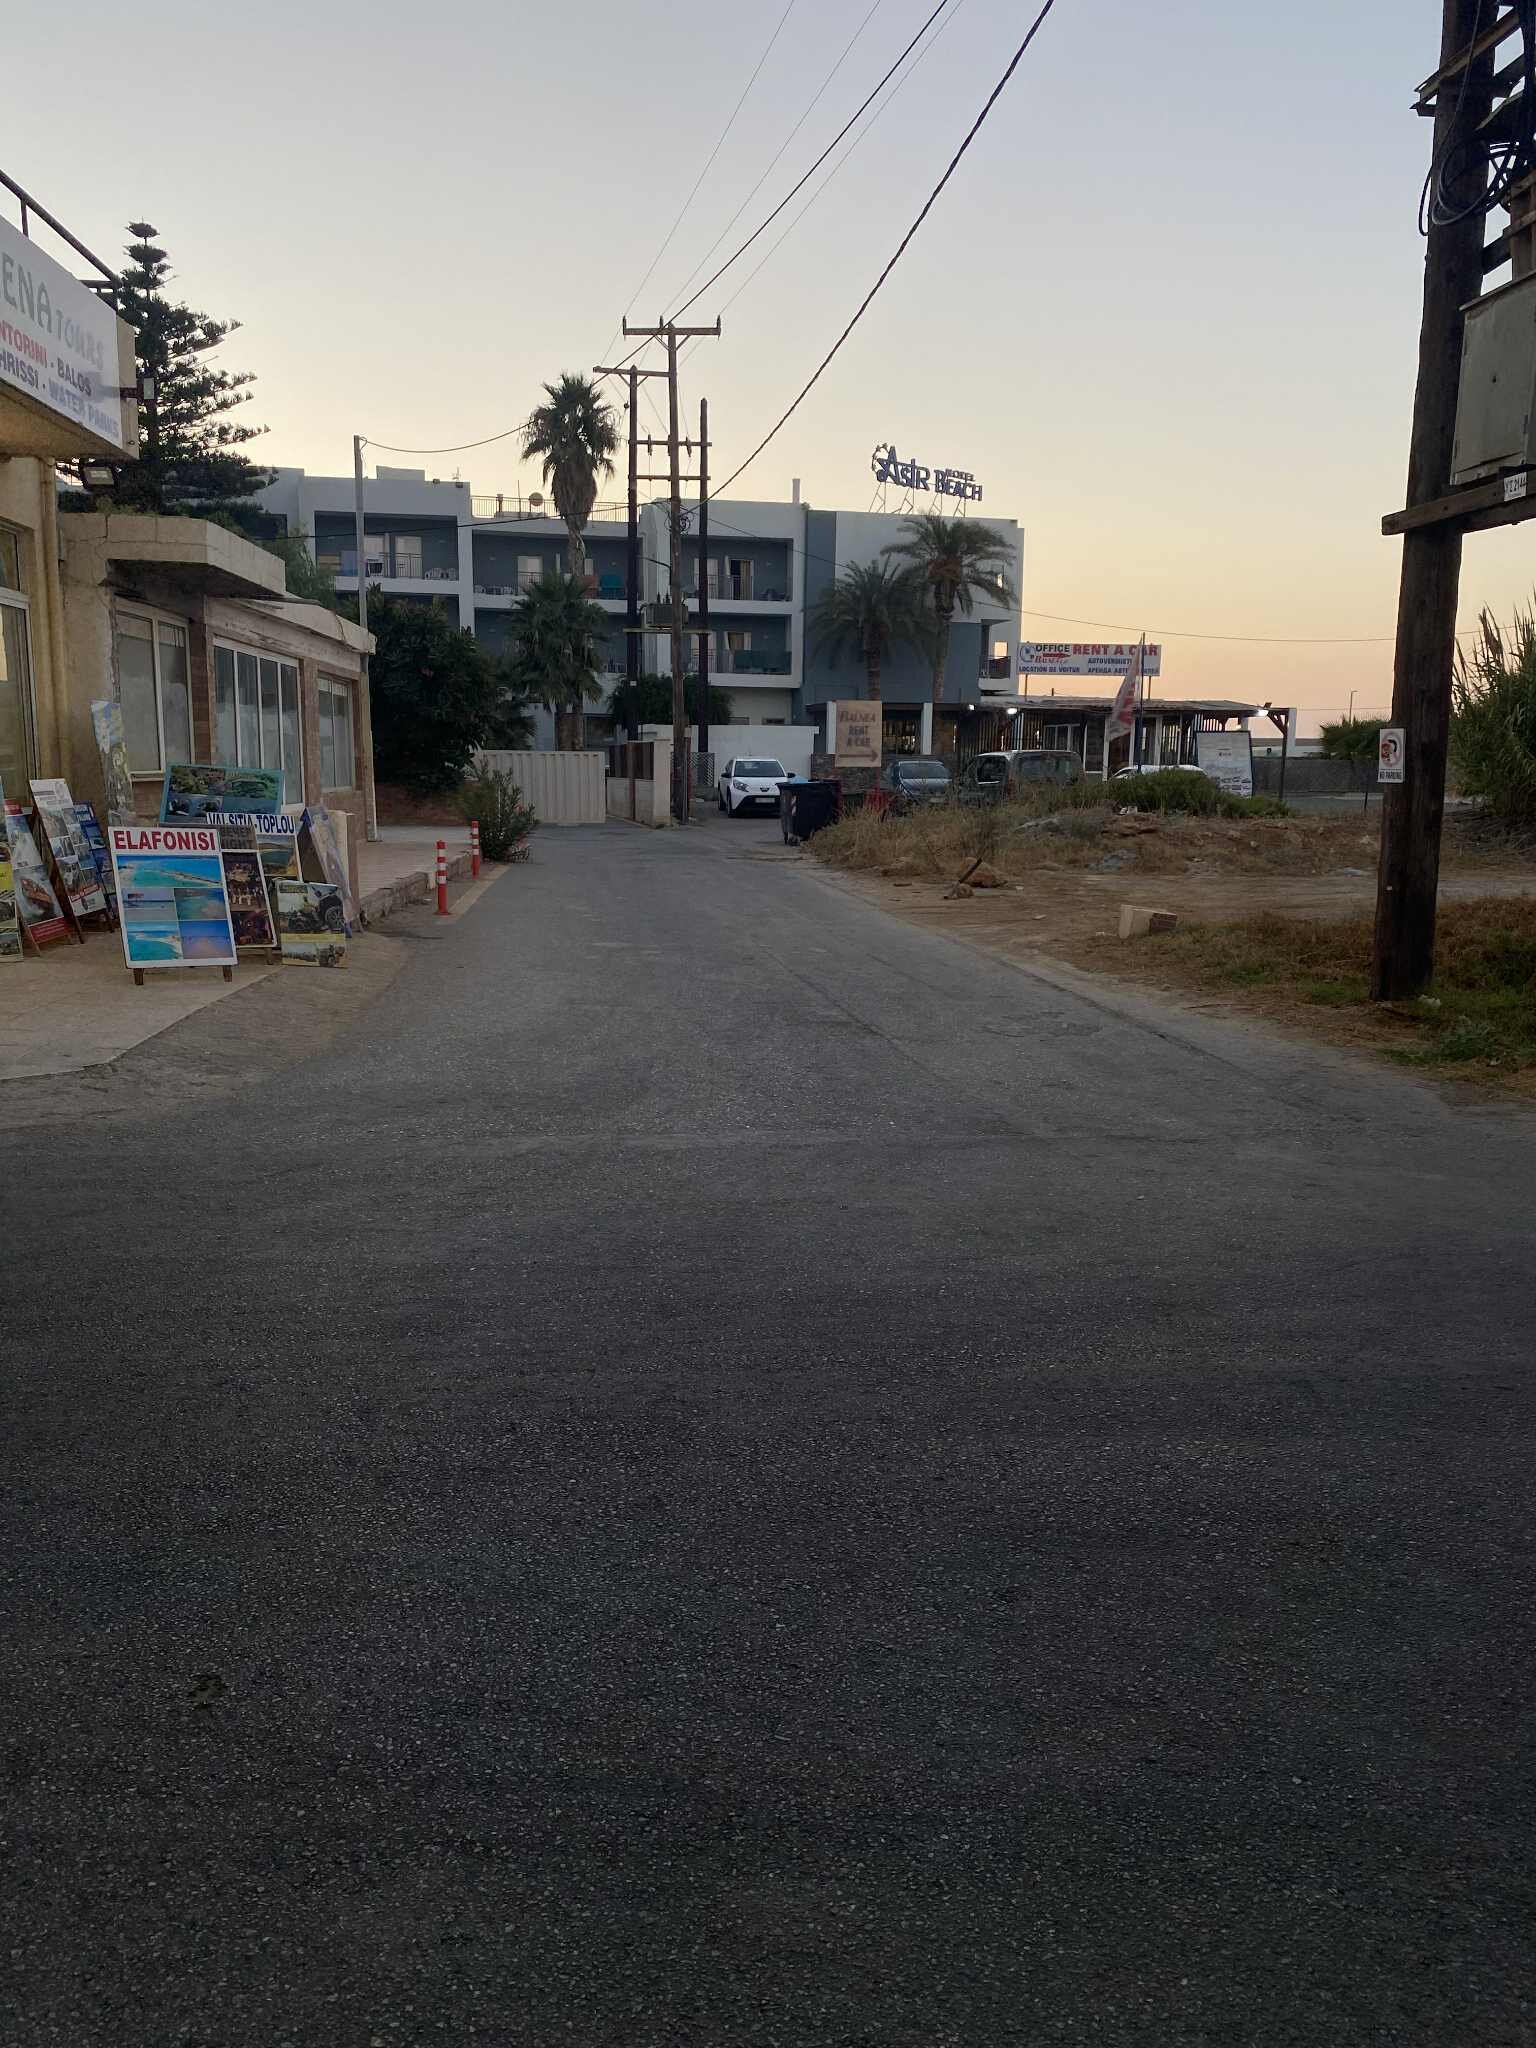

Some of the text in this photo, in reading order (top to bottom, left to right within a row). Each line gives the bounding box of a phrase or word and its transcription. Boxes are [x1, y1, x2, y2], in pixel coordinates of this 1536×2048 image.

[57, 356, 92, 398] BALOS
[48, 376, 85, 418] WATER
[934, 468, 984, 502] BEACH
[1035, 644, 1070, 653] OFFICE
[1072, 644, 1108, 656] RENT
[1113, 644, 1124, 656] A
[1018, 665, 1048, 673] LOCATION
[112, 830, 216, 851] ELAFONISI
